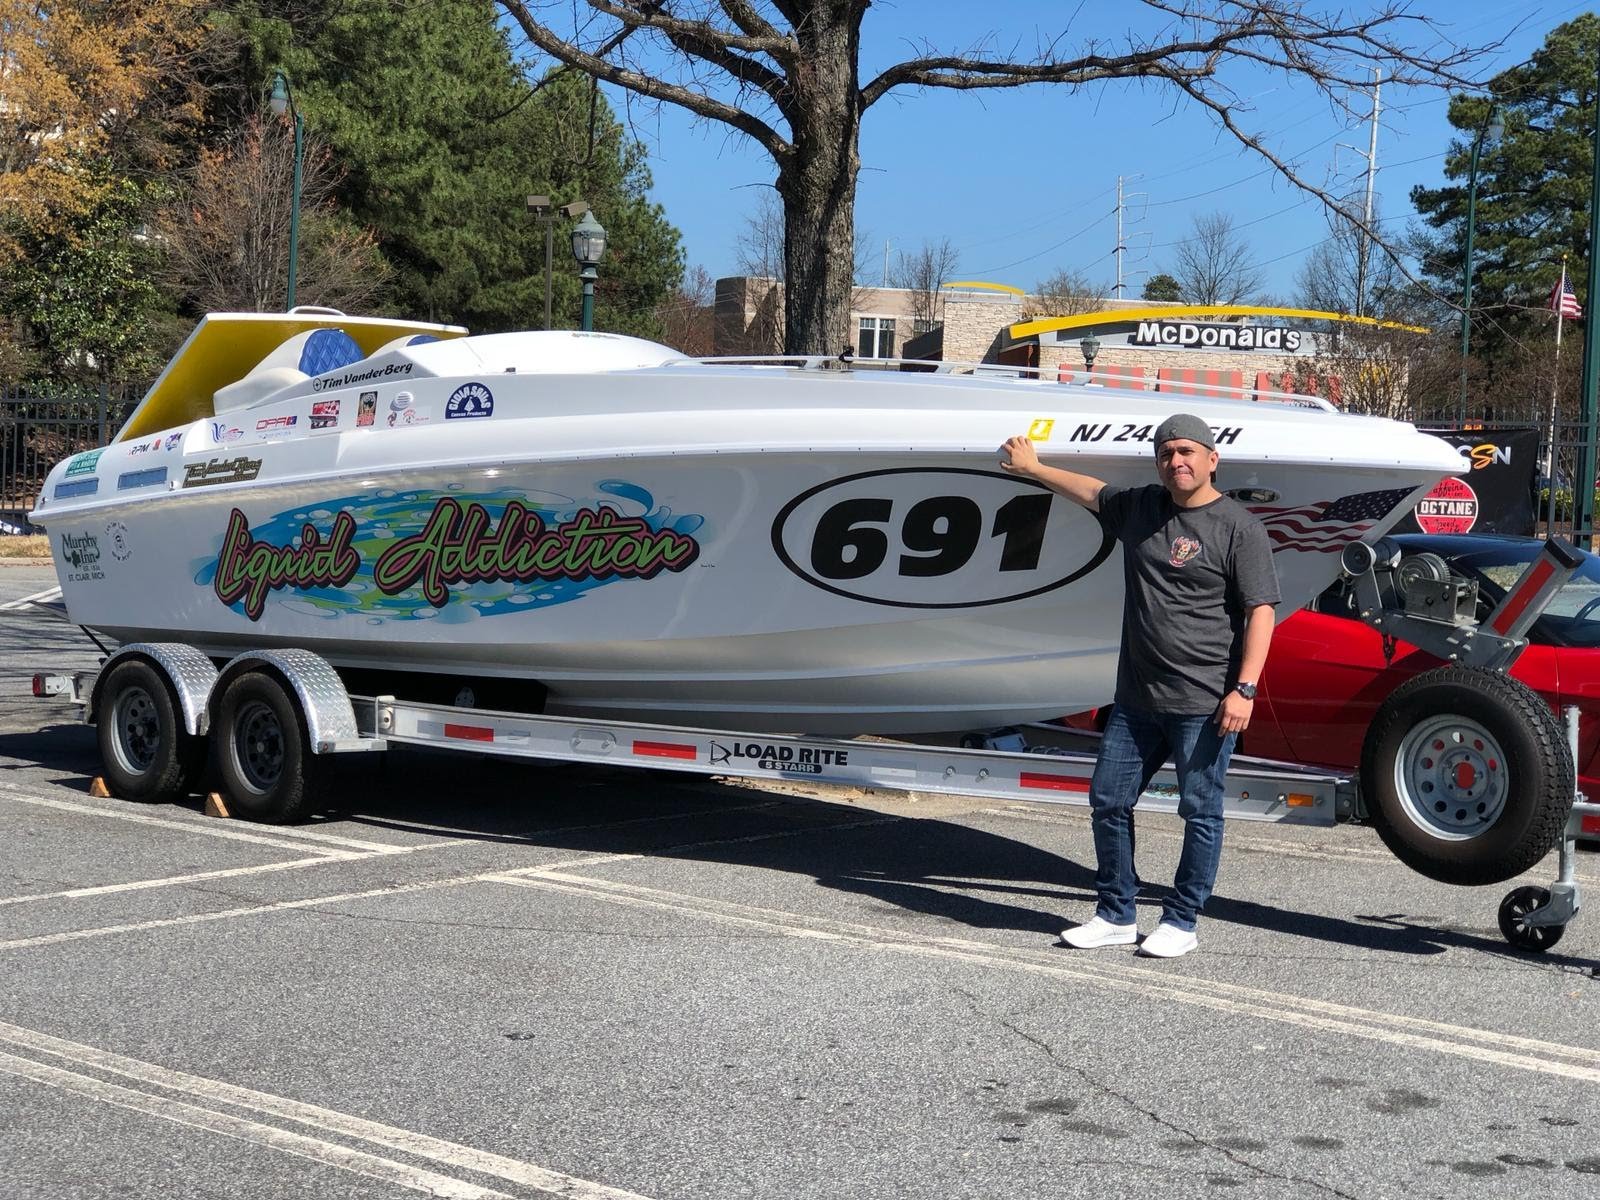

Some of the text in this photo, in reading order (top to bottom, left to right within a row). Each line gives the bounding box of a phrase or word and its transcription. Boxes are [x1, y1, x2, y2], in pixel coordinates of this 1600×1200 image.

[1137, 322, 1300, 349] McDonald's
[321, 362, 413, 390] Tim VanderBerg
[471, 386, 491, 409] SAILS
[1070, 424, 1111, 442] NJ
[1113, 424, 1154, 442] 24
[1432, 482, 1464, 498] affeine
[1420, 501, 1473, 515] OCTANE
[61, 531, 98, 552] Murphy
[811, 494, 1054, 580] 691
[80, 549, 97, 564] Inn
[215, 497, 699, 621] Liquid Addiction
[733, 743, 849, 766] LOAD RITE
[774, 762, 816, 773] STARR
